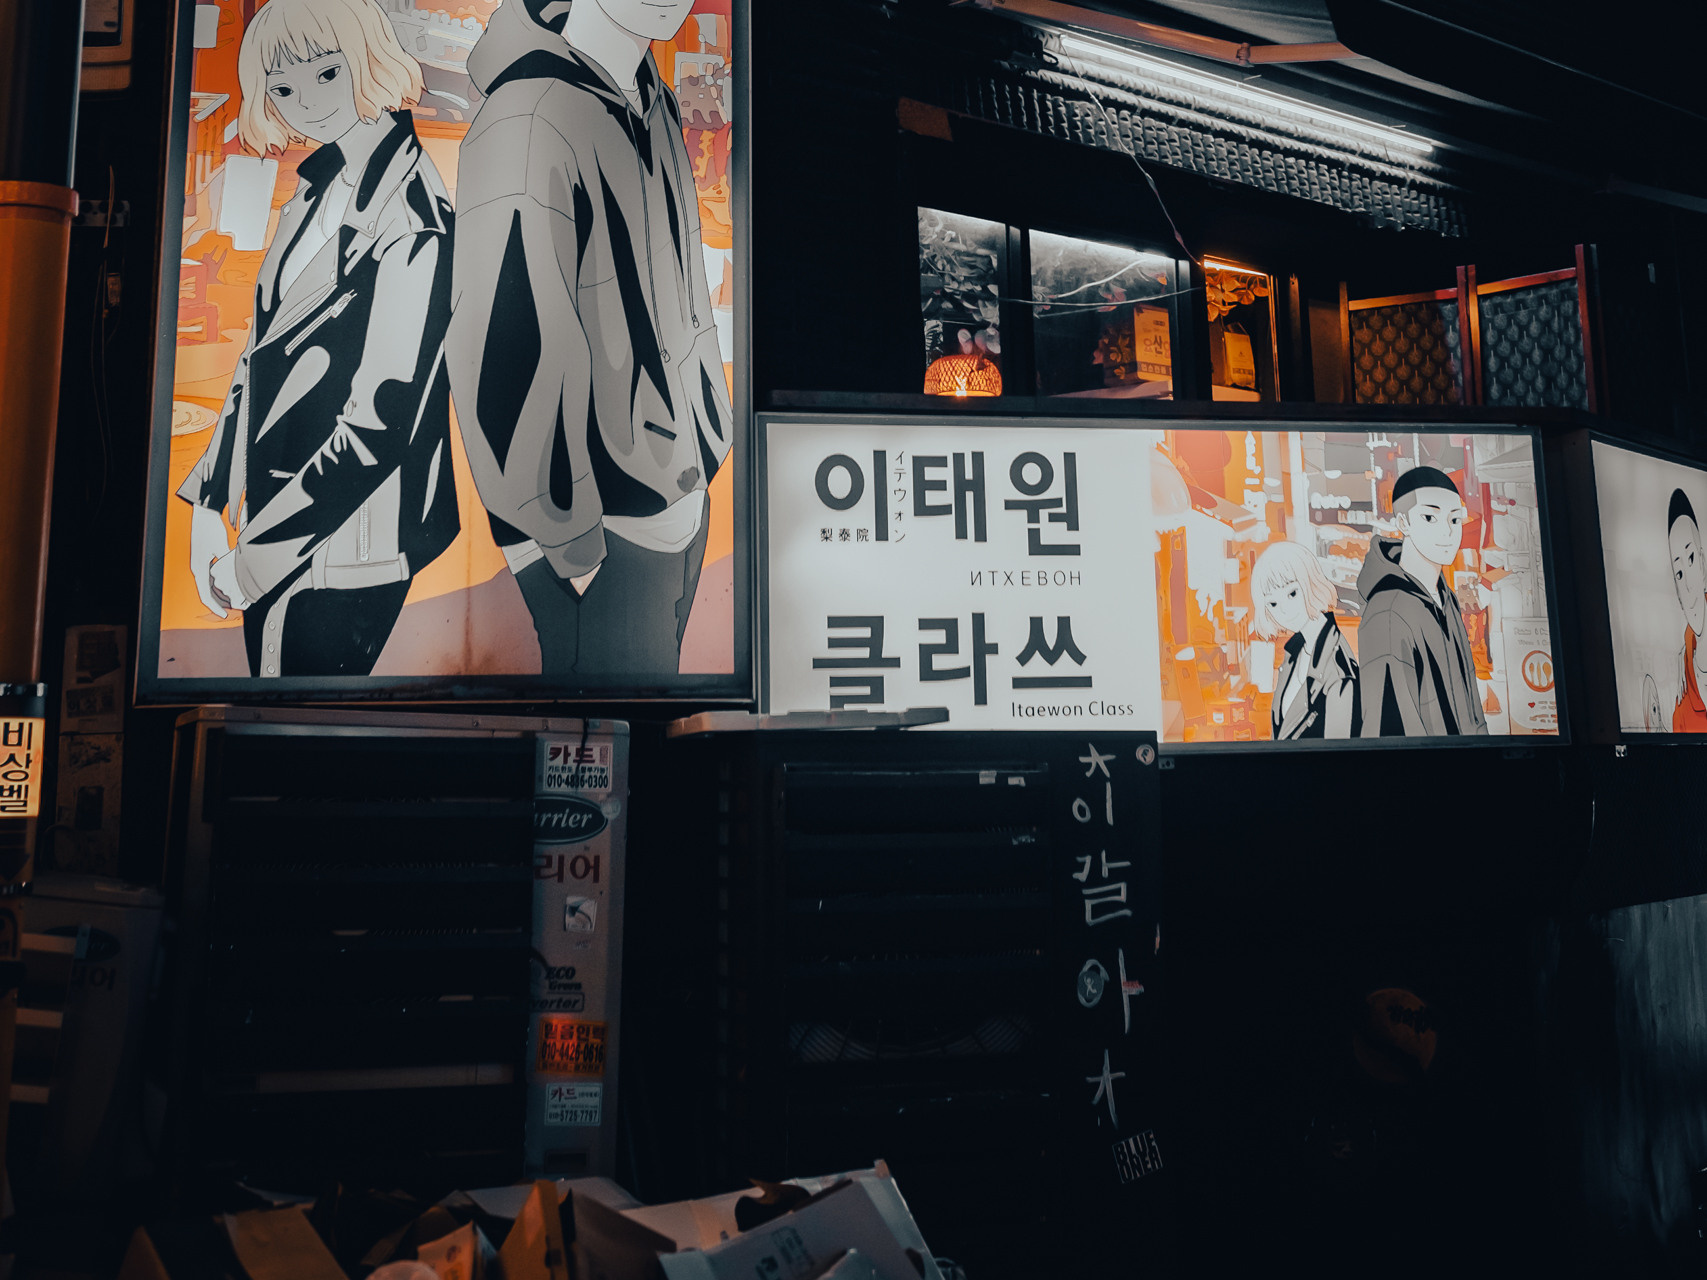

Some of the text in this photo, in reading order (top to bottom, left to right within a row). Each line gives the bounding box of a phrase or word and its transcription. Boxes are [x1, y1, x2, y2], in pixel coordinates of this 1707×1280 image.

[814, 449, 1081, 556] 이태원
[820, 527, 870, 542] 梨泰院
[812, 612, 1093, 709] 클라쓰
[1011, 700, 1135, 718] Itaewon Class
[0, 721, 33, 813] 비상벨
[548, 745, 596, 765] 카드
